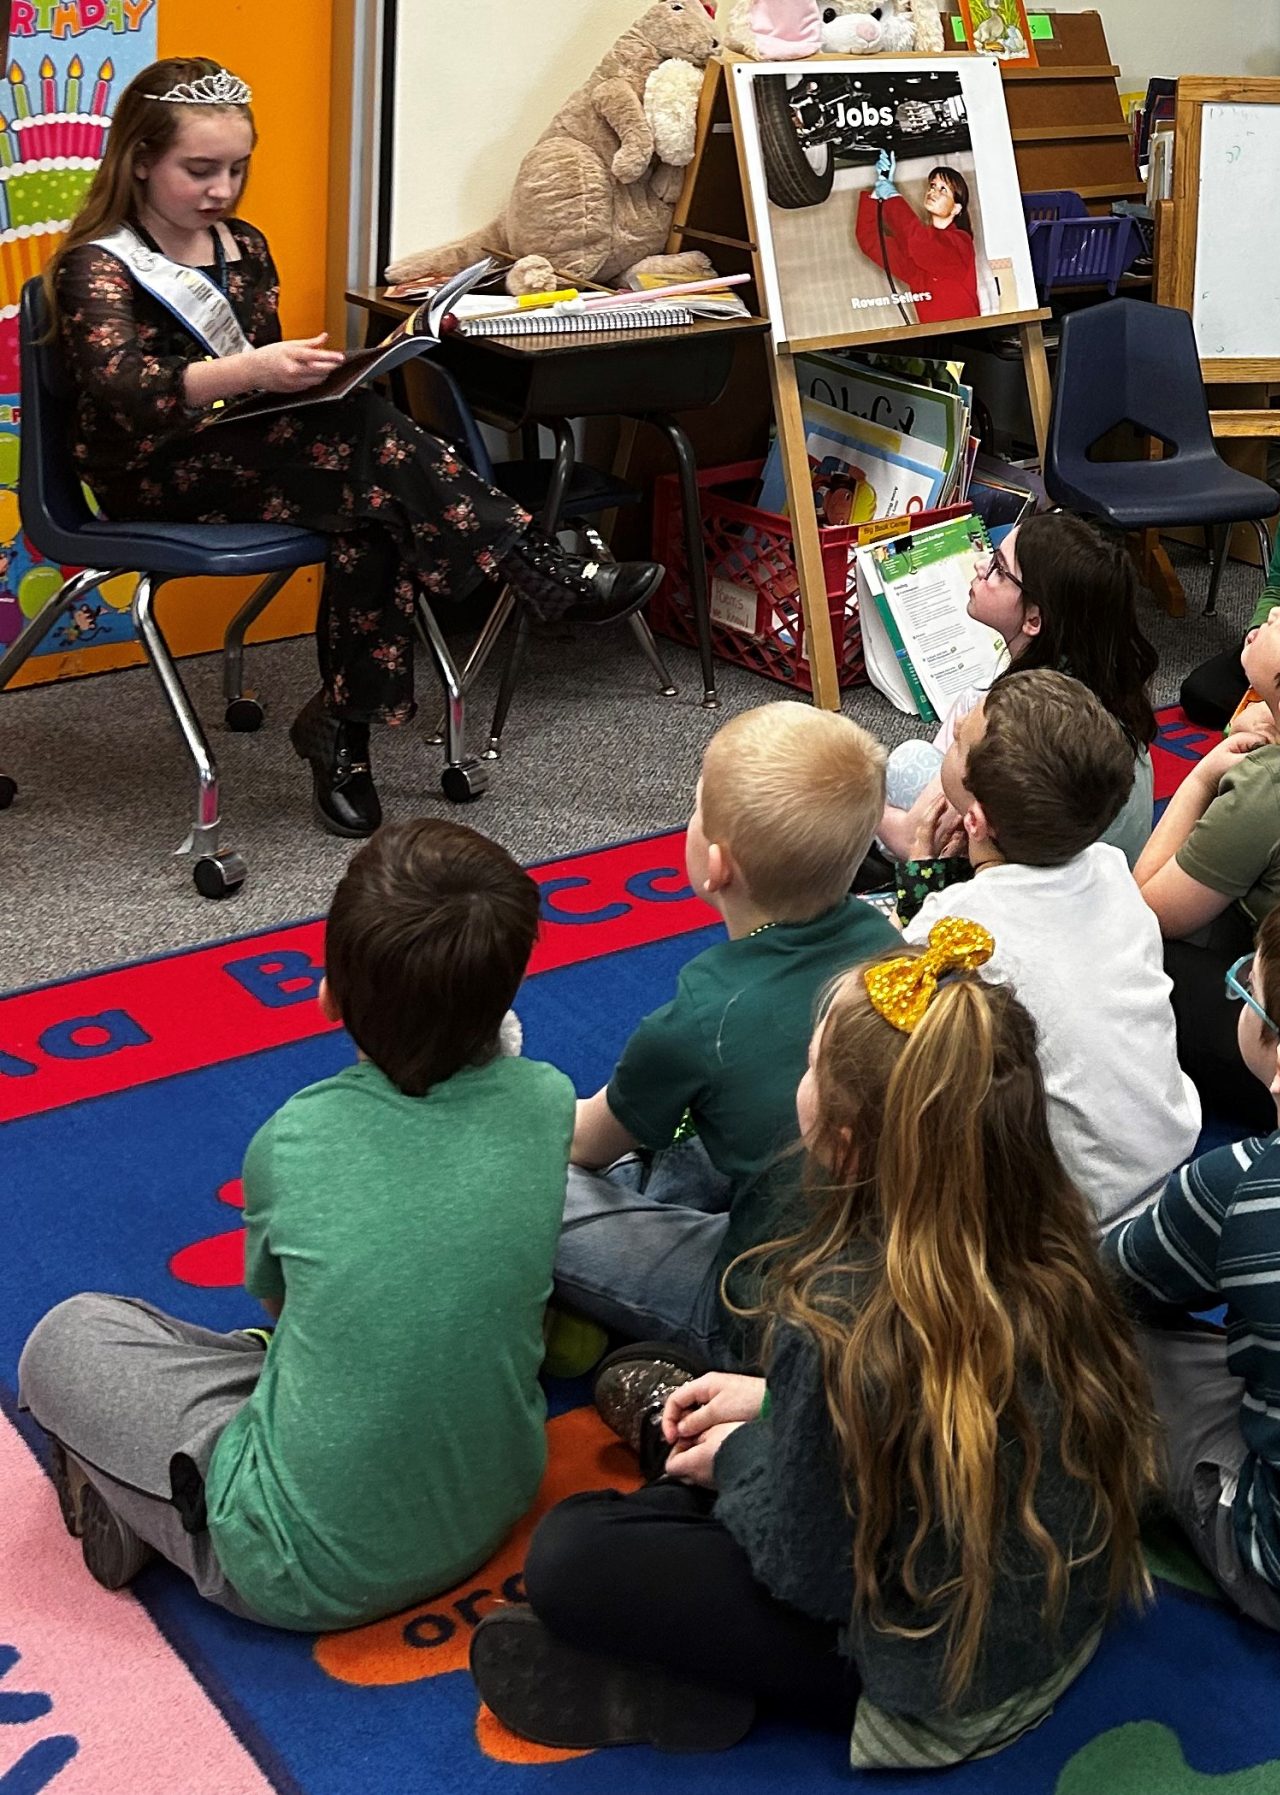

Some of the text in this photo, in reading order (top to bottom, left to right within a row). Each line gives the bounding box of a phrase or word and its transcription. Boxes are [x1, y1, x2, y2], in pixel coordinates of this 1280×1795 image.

[836, 101, 894, 128] Jobs
[851, 291, 932, 309] Rowan Sellers
